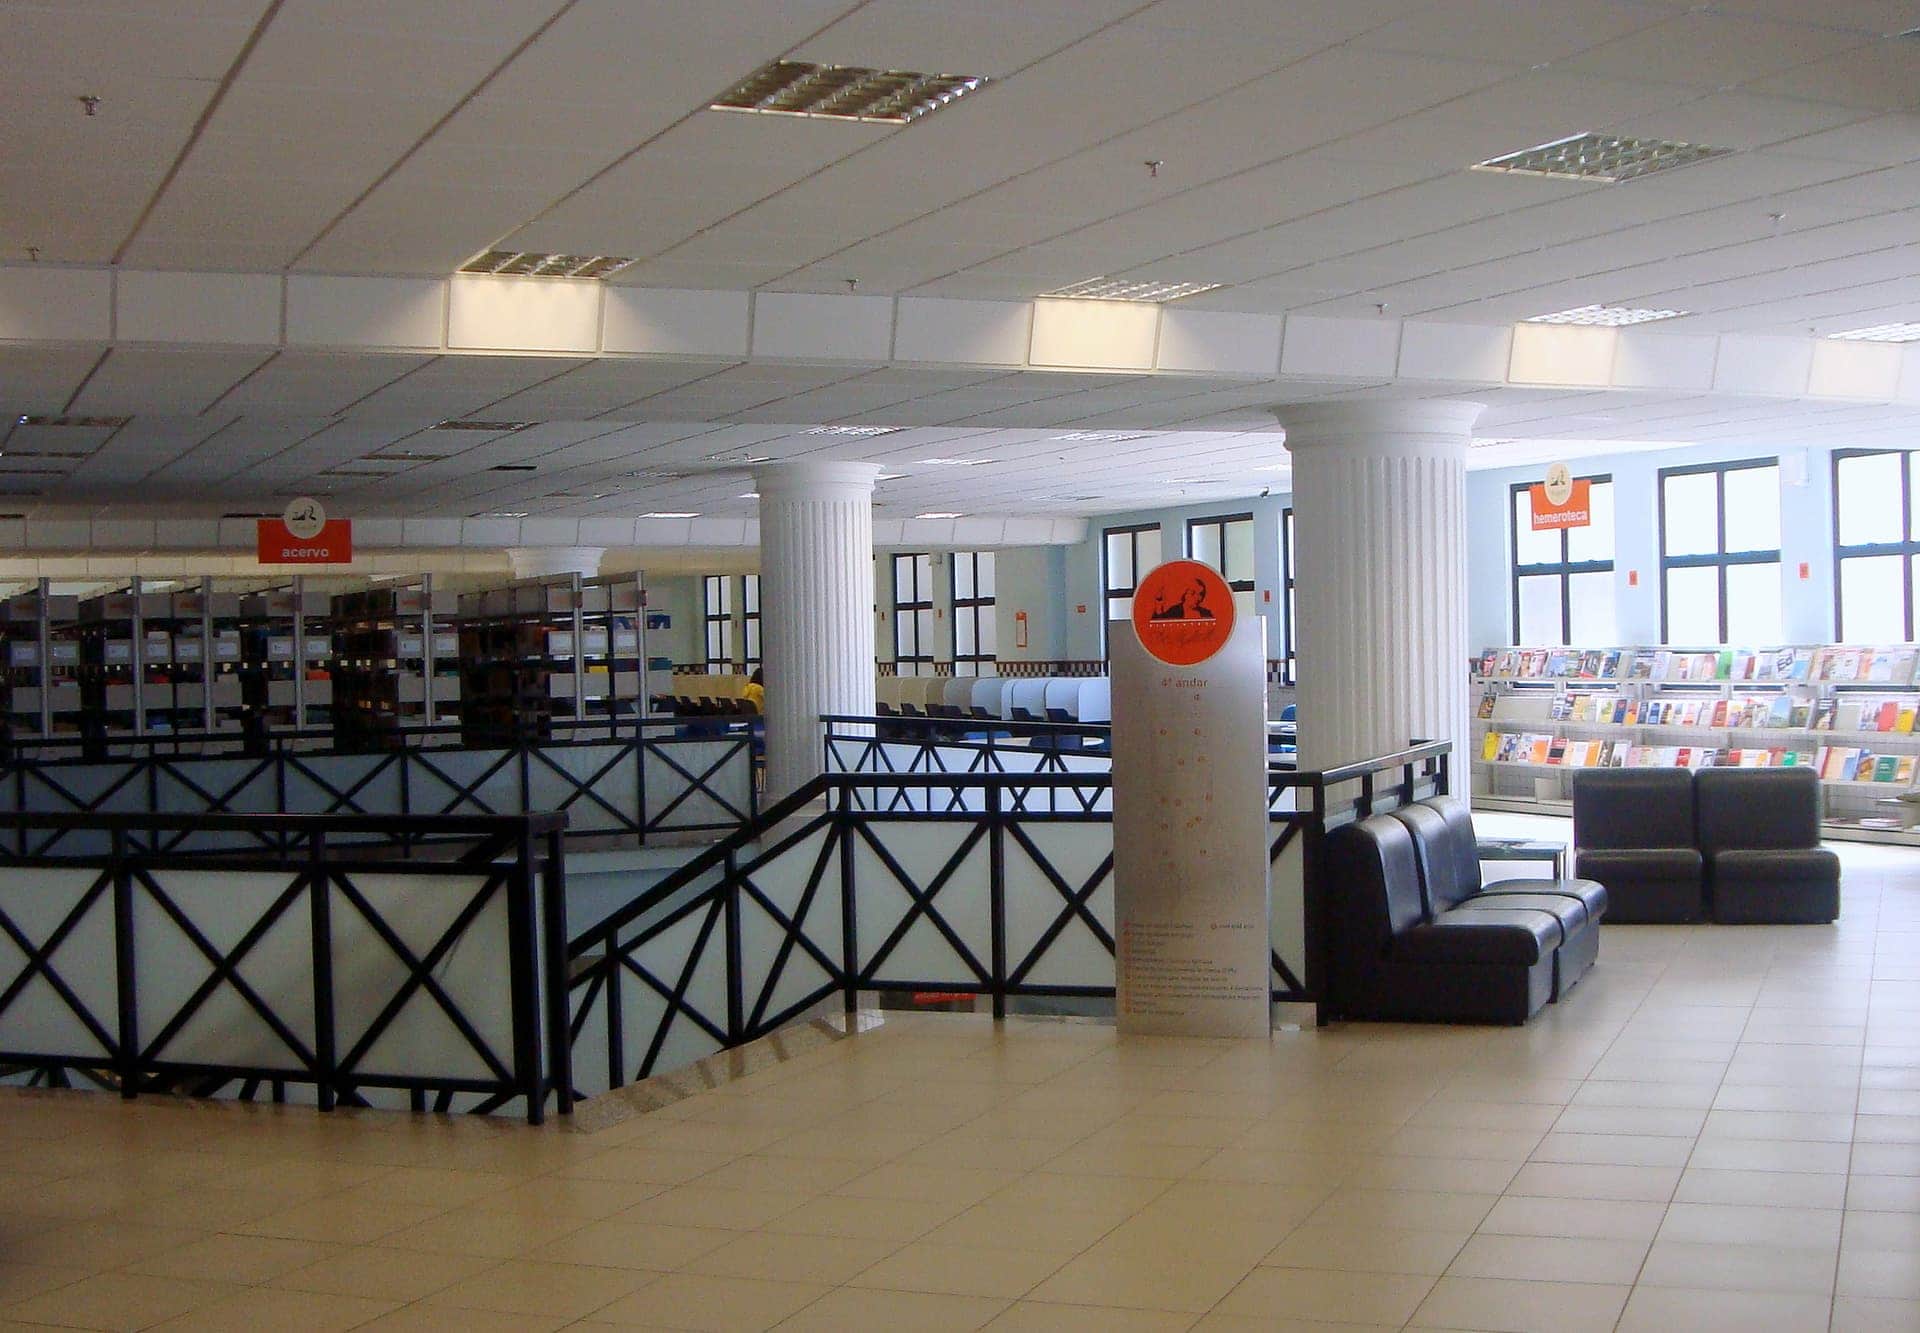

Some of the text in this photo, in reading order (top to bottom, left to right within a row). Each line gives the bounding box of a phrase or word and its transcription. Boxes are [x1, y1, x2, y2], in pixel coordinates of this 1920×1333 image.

[1533, 510, 1587, 524] hemeroteca
[282, 548, 329, 558] acervo
[1176, 677, 1208, 688] andar
